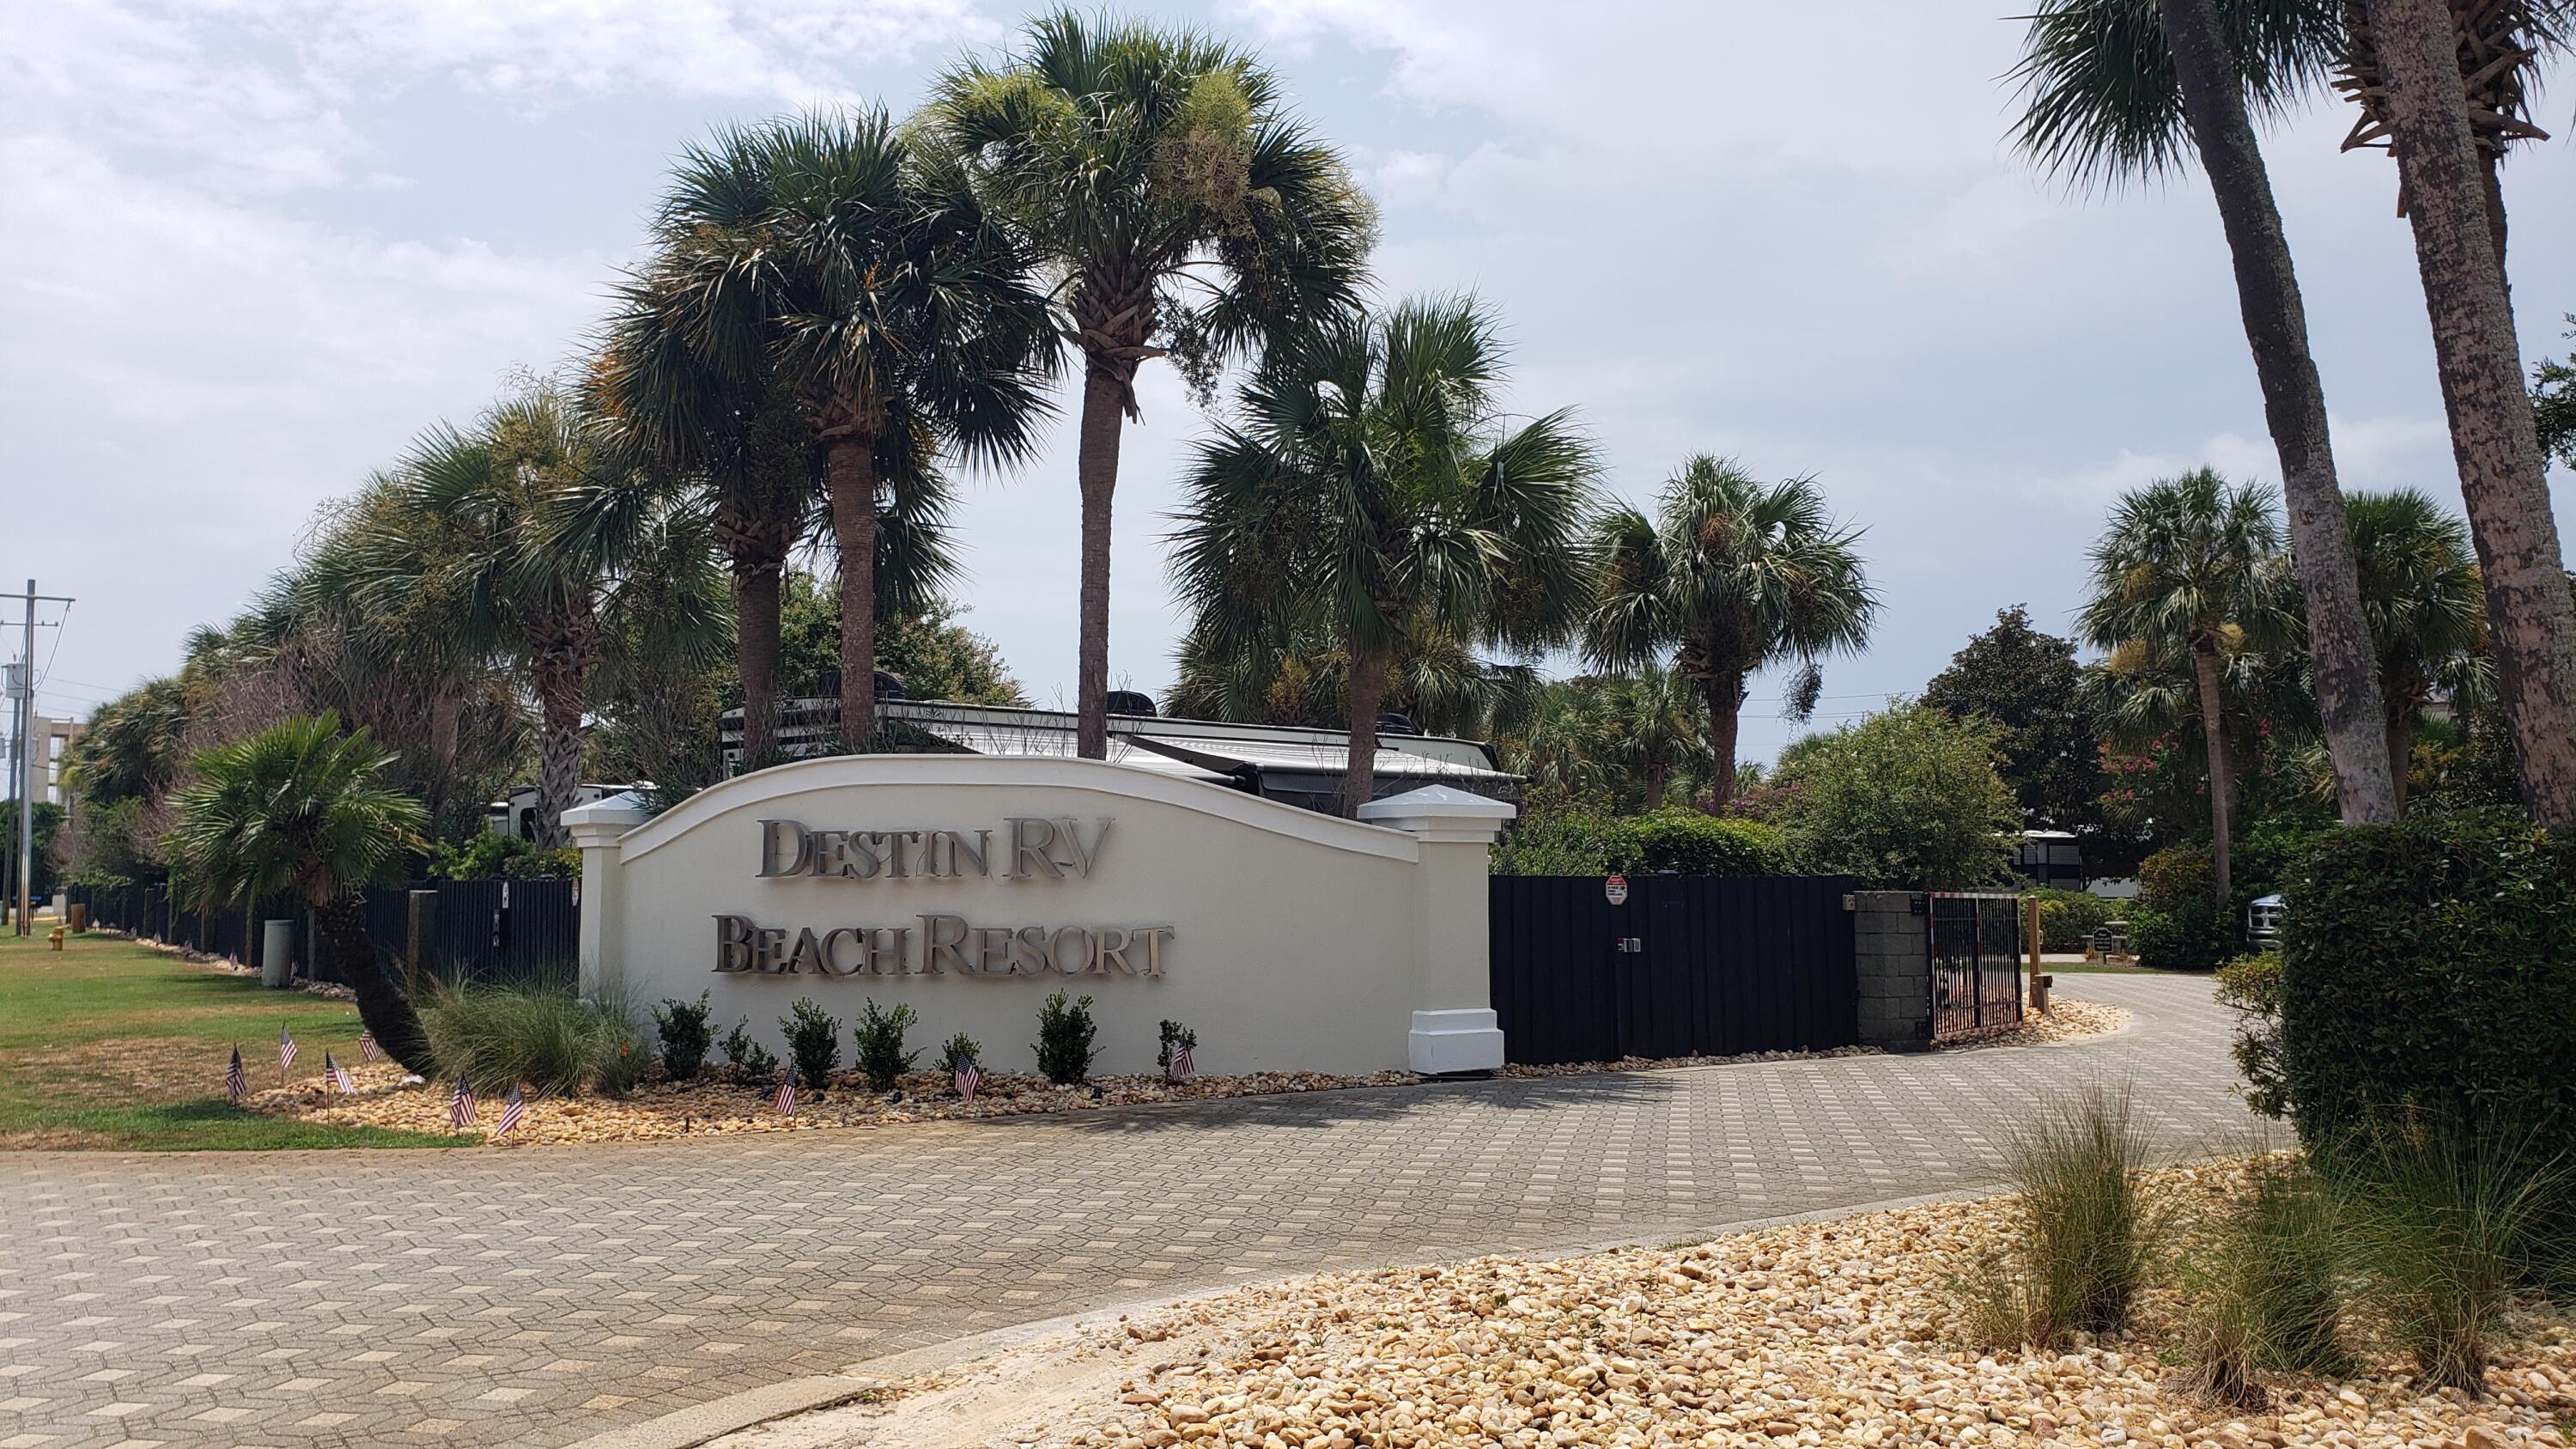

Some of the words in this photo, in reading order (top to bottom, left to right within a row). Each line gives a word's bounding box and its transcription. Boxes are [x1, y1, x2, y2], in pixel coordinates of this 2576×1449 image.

[756, 819, 993, 879] DESTIN
[1002, 817, 1115, 880] RV
[711, 914, 912, 976] BEACH
[915, 914, 1175, 977] RESORT
